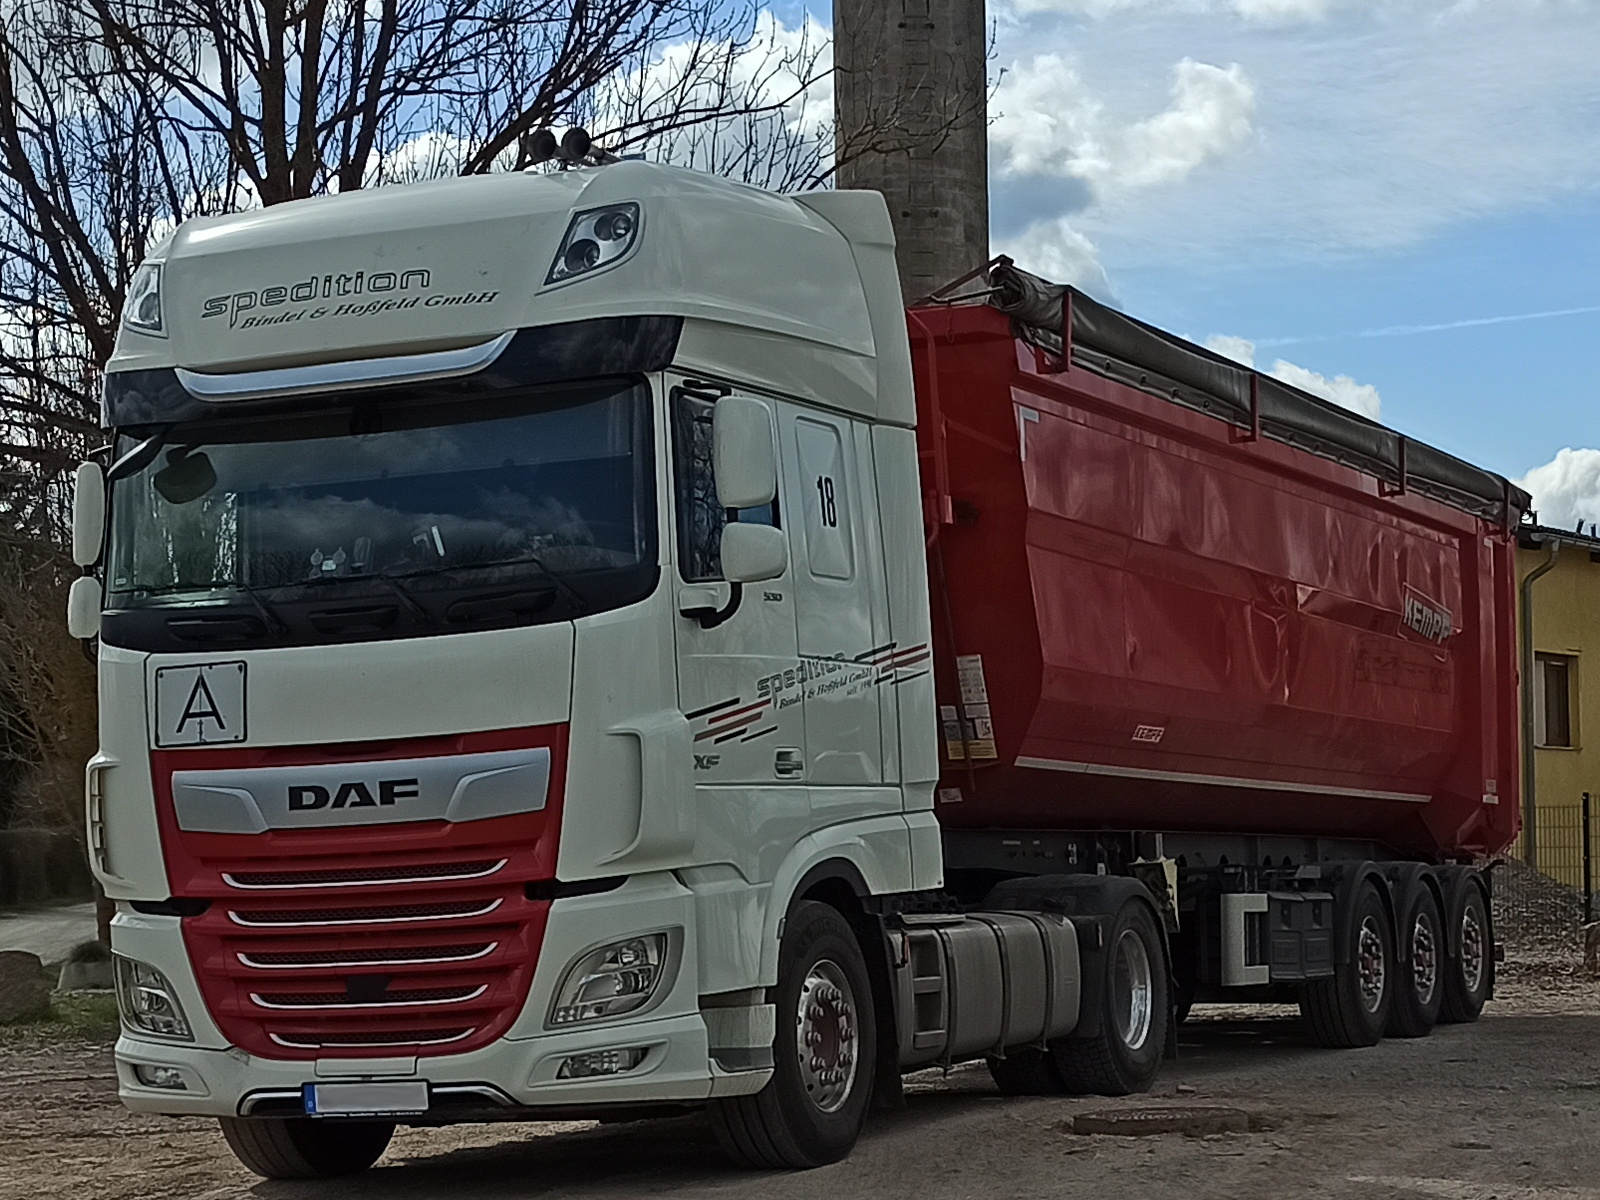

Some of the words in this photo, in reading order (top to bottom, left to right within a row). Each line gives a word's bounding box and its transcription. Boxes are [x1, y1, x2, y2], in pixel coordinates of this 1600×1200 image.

[201, 268, 431, 329] spedition
[240, 308, 306, 330] Bindel
[310, 307, 330, 319] &
[424, 291, 500, 307] GmbH
[816, 475, 837, 528] 18
[1403, 588, 1452, 645] KEMPF
[175, 673, 226, 733] A
[693, 754, 721, 770] XF
[288, 778, 419, 811] DAF
